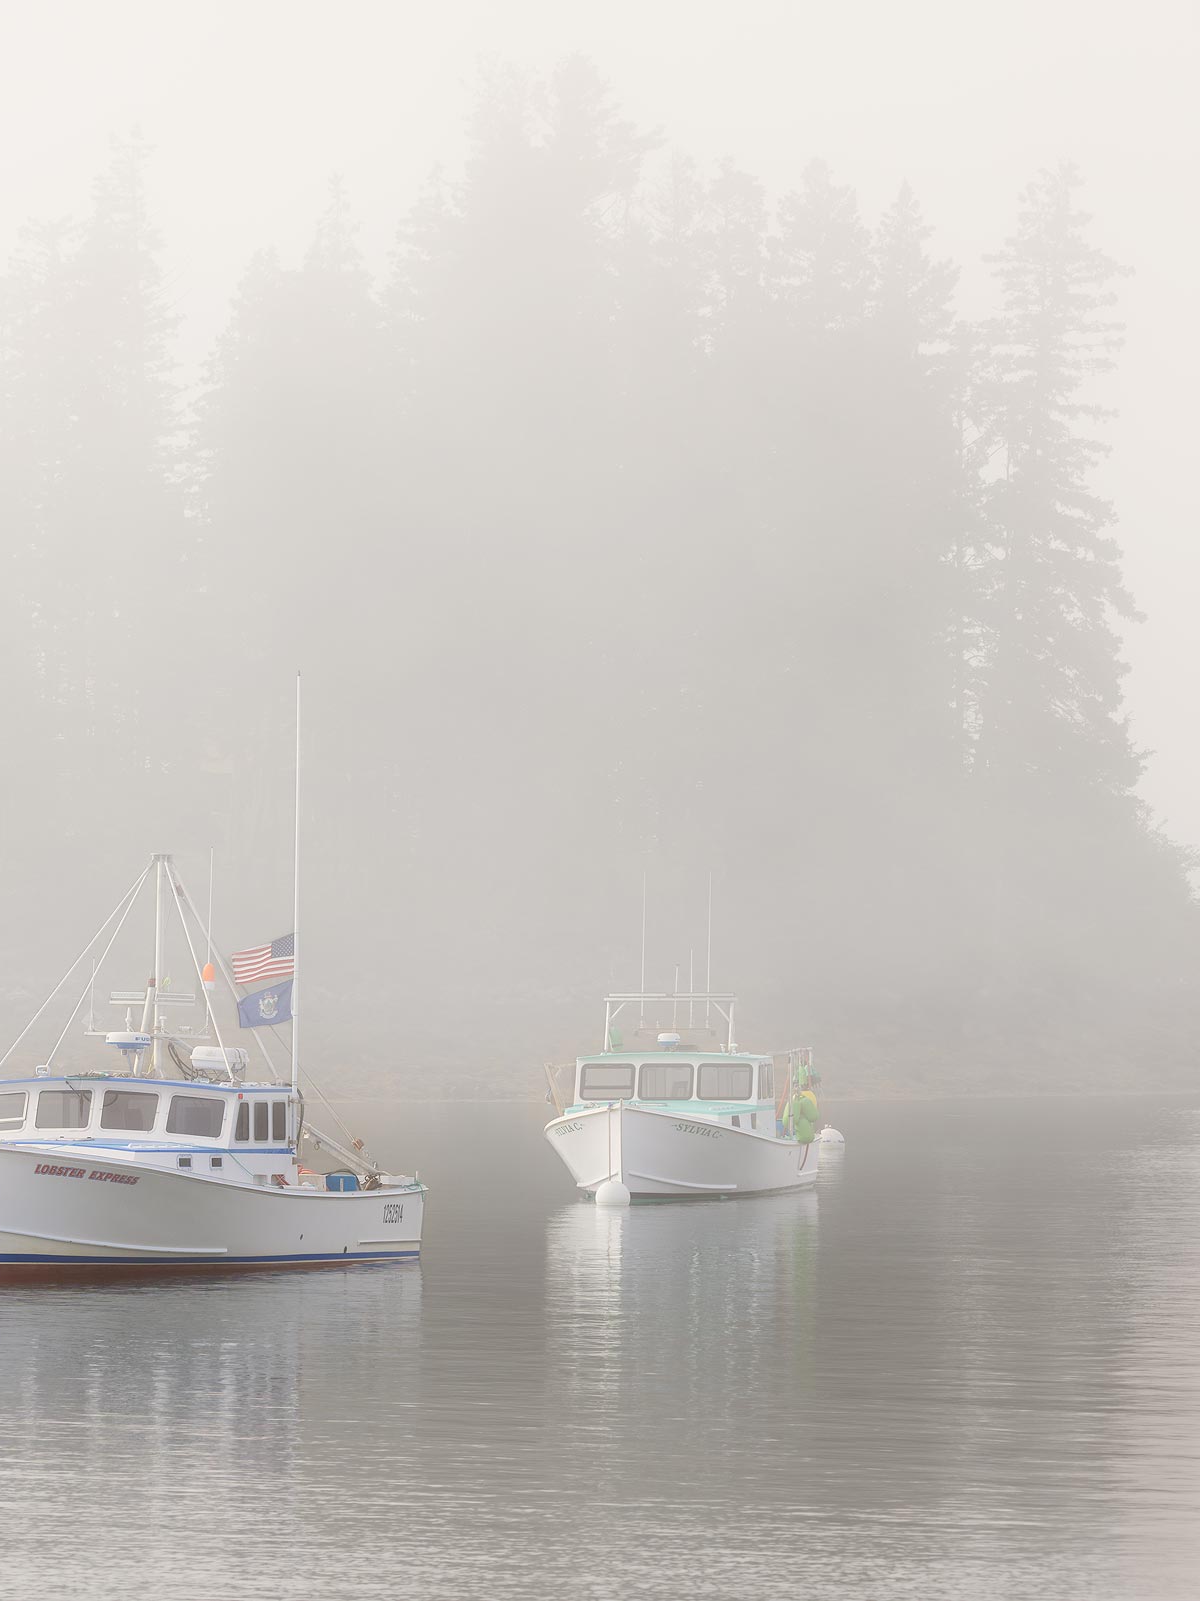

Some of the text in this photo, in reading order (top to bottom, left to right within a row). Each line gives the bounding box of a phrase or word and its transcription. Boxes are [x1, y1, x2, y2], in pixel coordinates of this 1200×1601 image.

[676, 1123, 711, 1137] SYLVIA
[34, 1163, 140, 1186] LOBSTER EXPRESS
